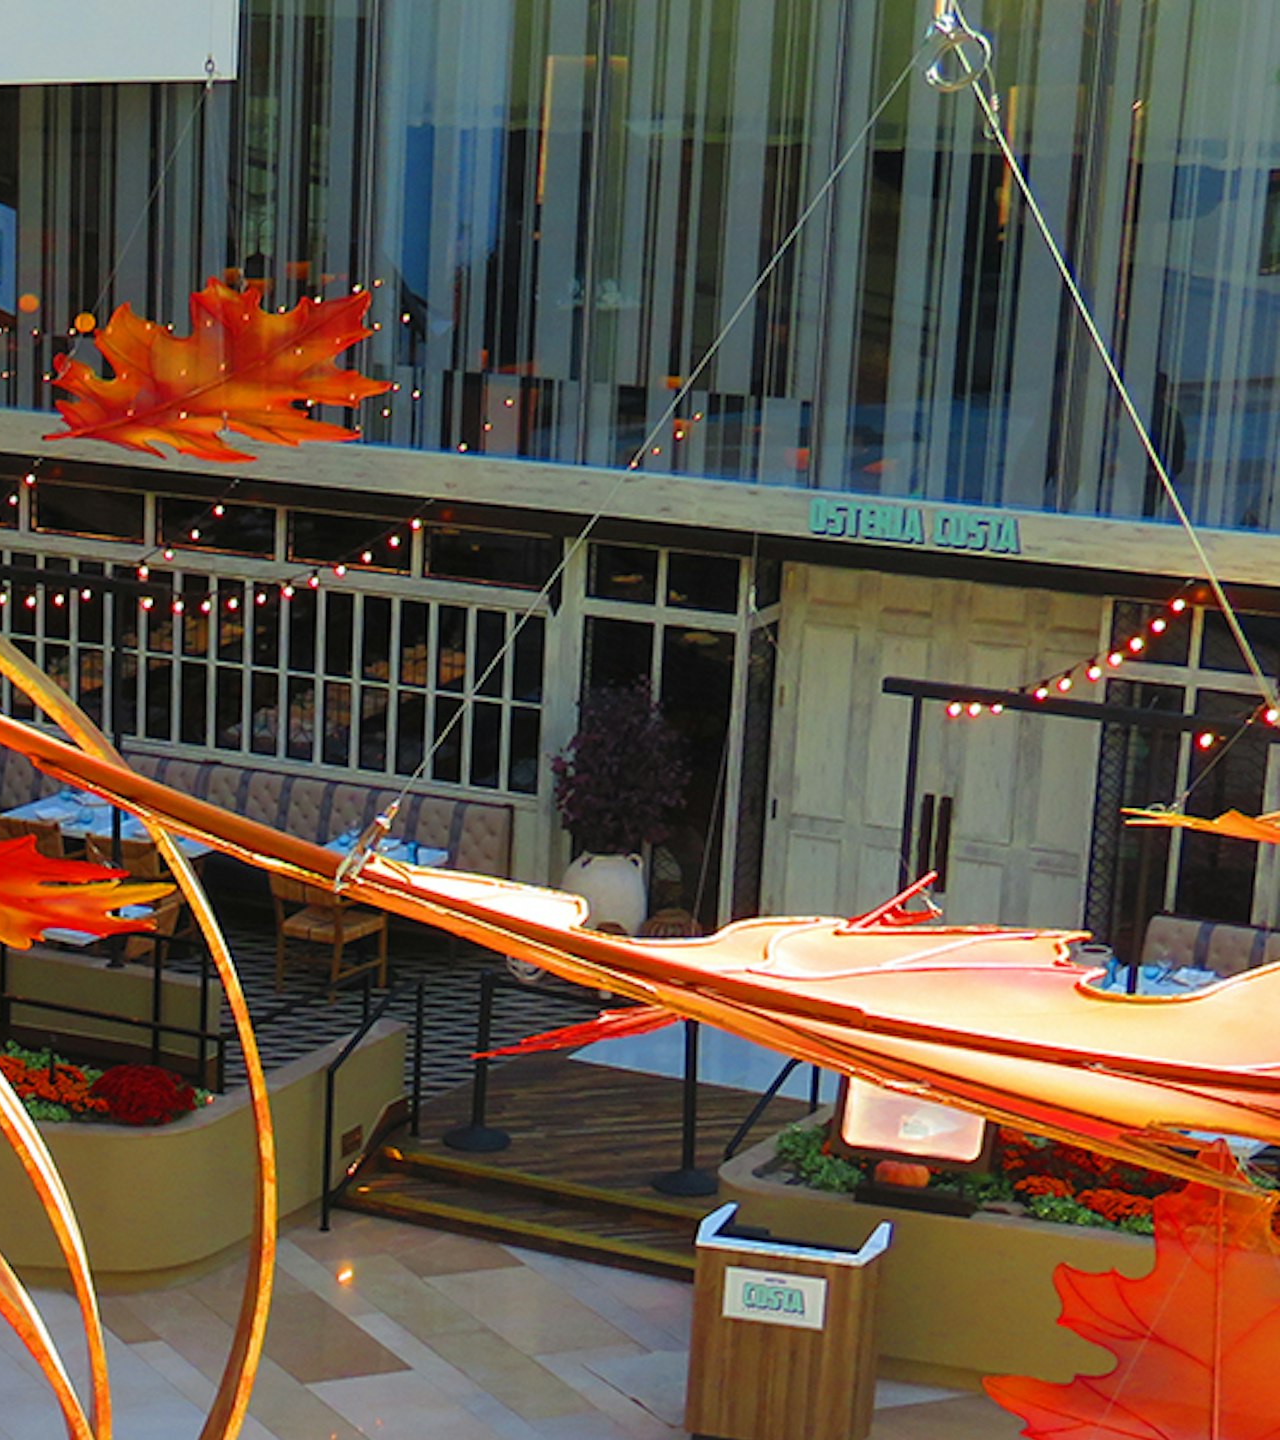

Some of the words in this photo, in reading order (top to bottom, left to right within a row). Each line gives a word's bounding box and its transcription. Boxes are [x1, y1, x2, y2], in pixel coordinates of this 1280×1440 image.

[809, 498, 925, 544] OSTERIA
[933, 512, 1022, 554] COSTA
[743, 1282, 805, 1314] COSTA
